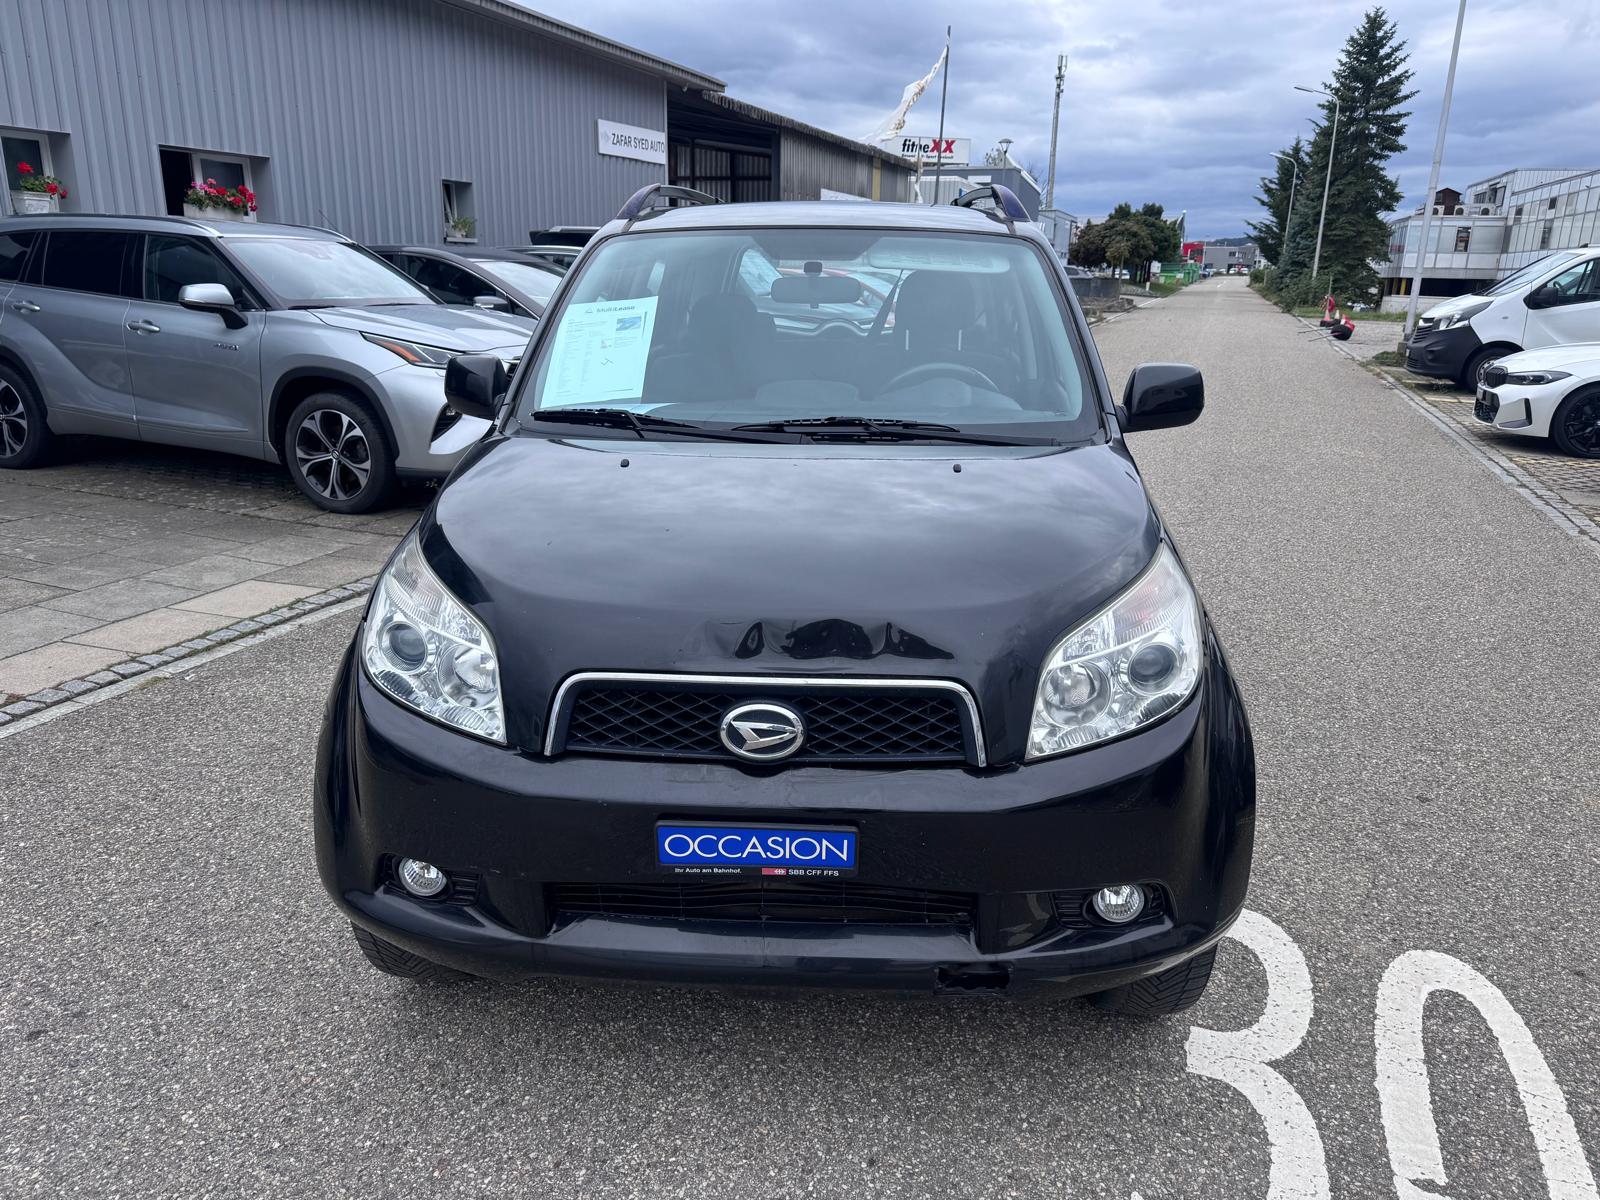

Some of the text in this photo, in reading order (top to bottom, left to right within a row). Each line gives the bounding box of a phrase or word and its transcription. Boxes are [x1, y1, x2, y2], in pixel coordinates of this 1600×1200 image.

[611, 133, 632, 148] ZAFAR
[634, 137, 649, 151] SYED
[664, 833, 848, 861] OCCASION
[788, 868, 805, 876] SBB
